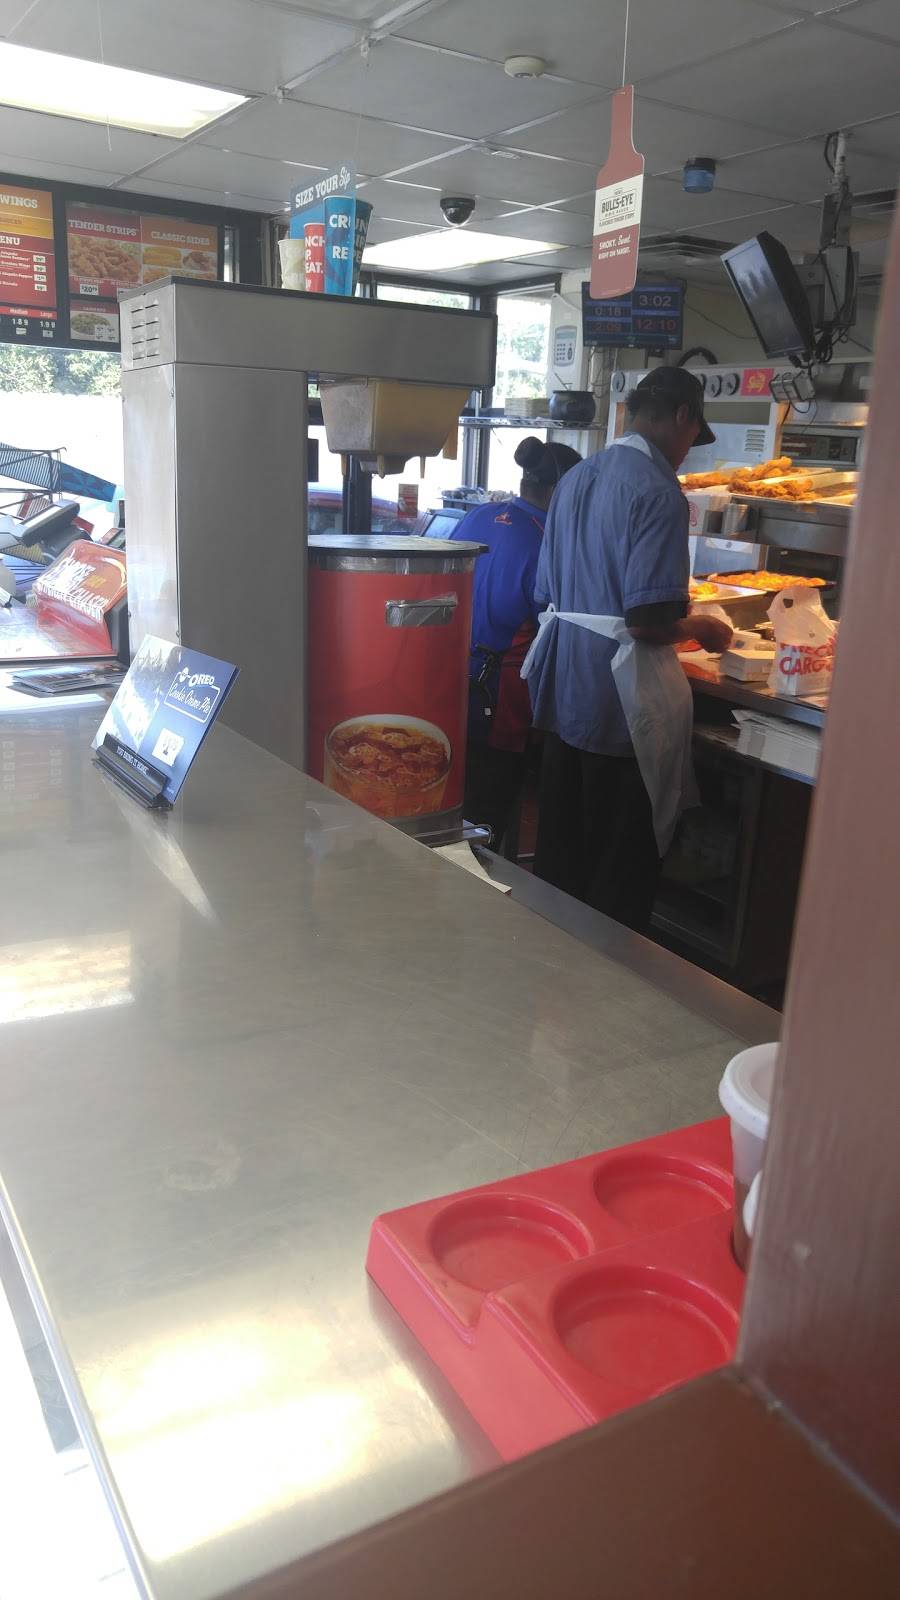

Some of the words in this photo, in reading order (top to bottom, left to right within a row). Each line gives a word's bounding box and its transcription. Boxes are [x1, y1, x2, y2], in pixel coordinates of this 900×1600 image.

[295, 187, 314, 208] SIZE
[316, 174, 338, 198] YOUR
[339, 166, 351, 190] Sip
[0, 193, 38, 209] WINGS
[68, 219, 106, 233] TENDER
[151, 230, 186, 243] CLASSIC
[186, 235, 211, 246] SIDES
[639, 295, 672, 308] 3:02
[188, 674, 215, 687] OREO
[169, 683, 186, 704] Cookie
[200, 697, 212, 714] Pie
